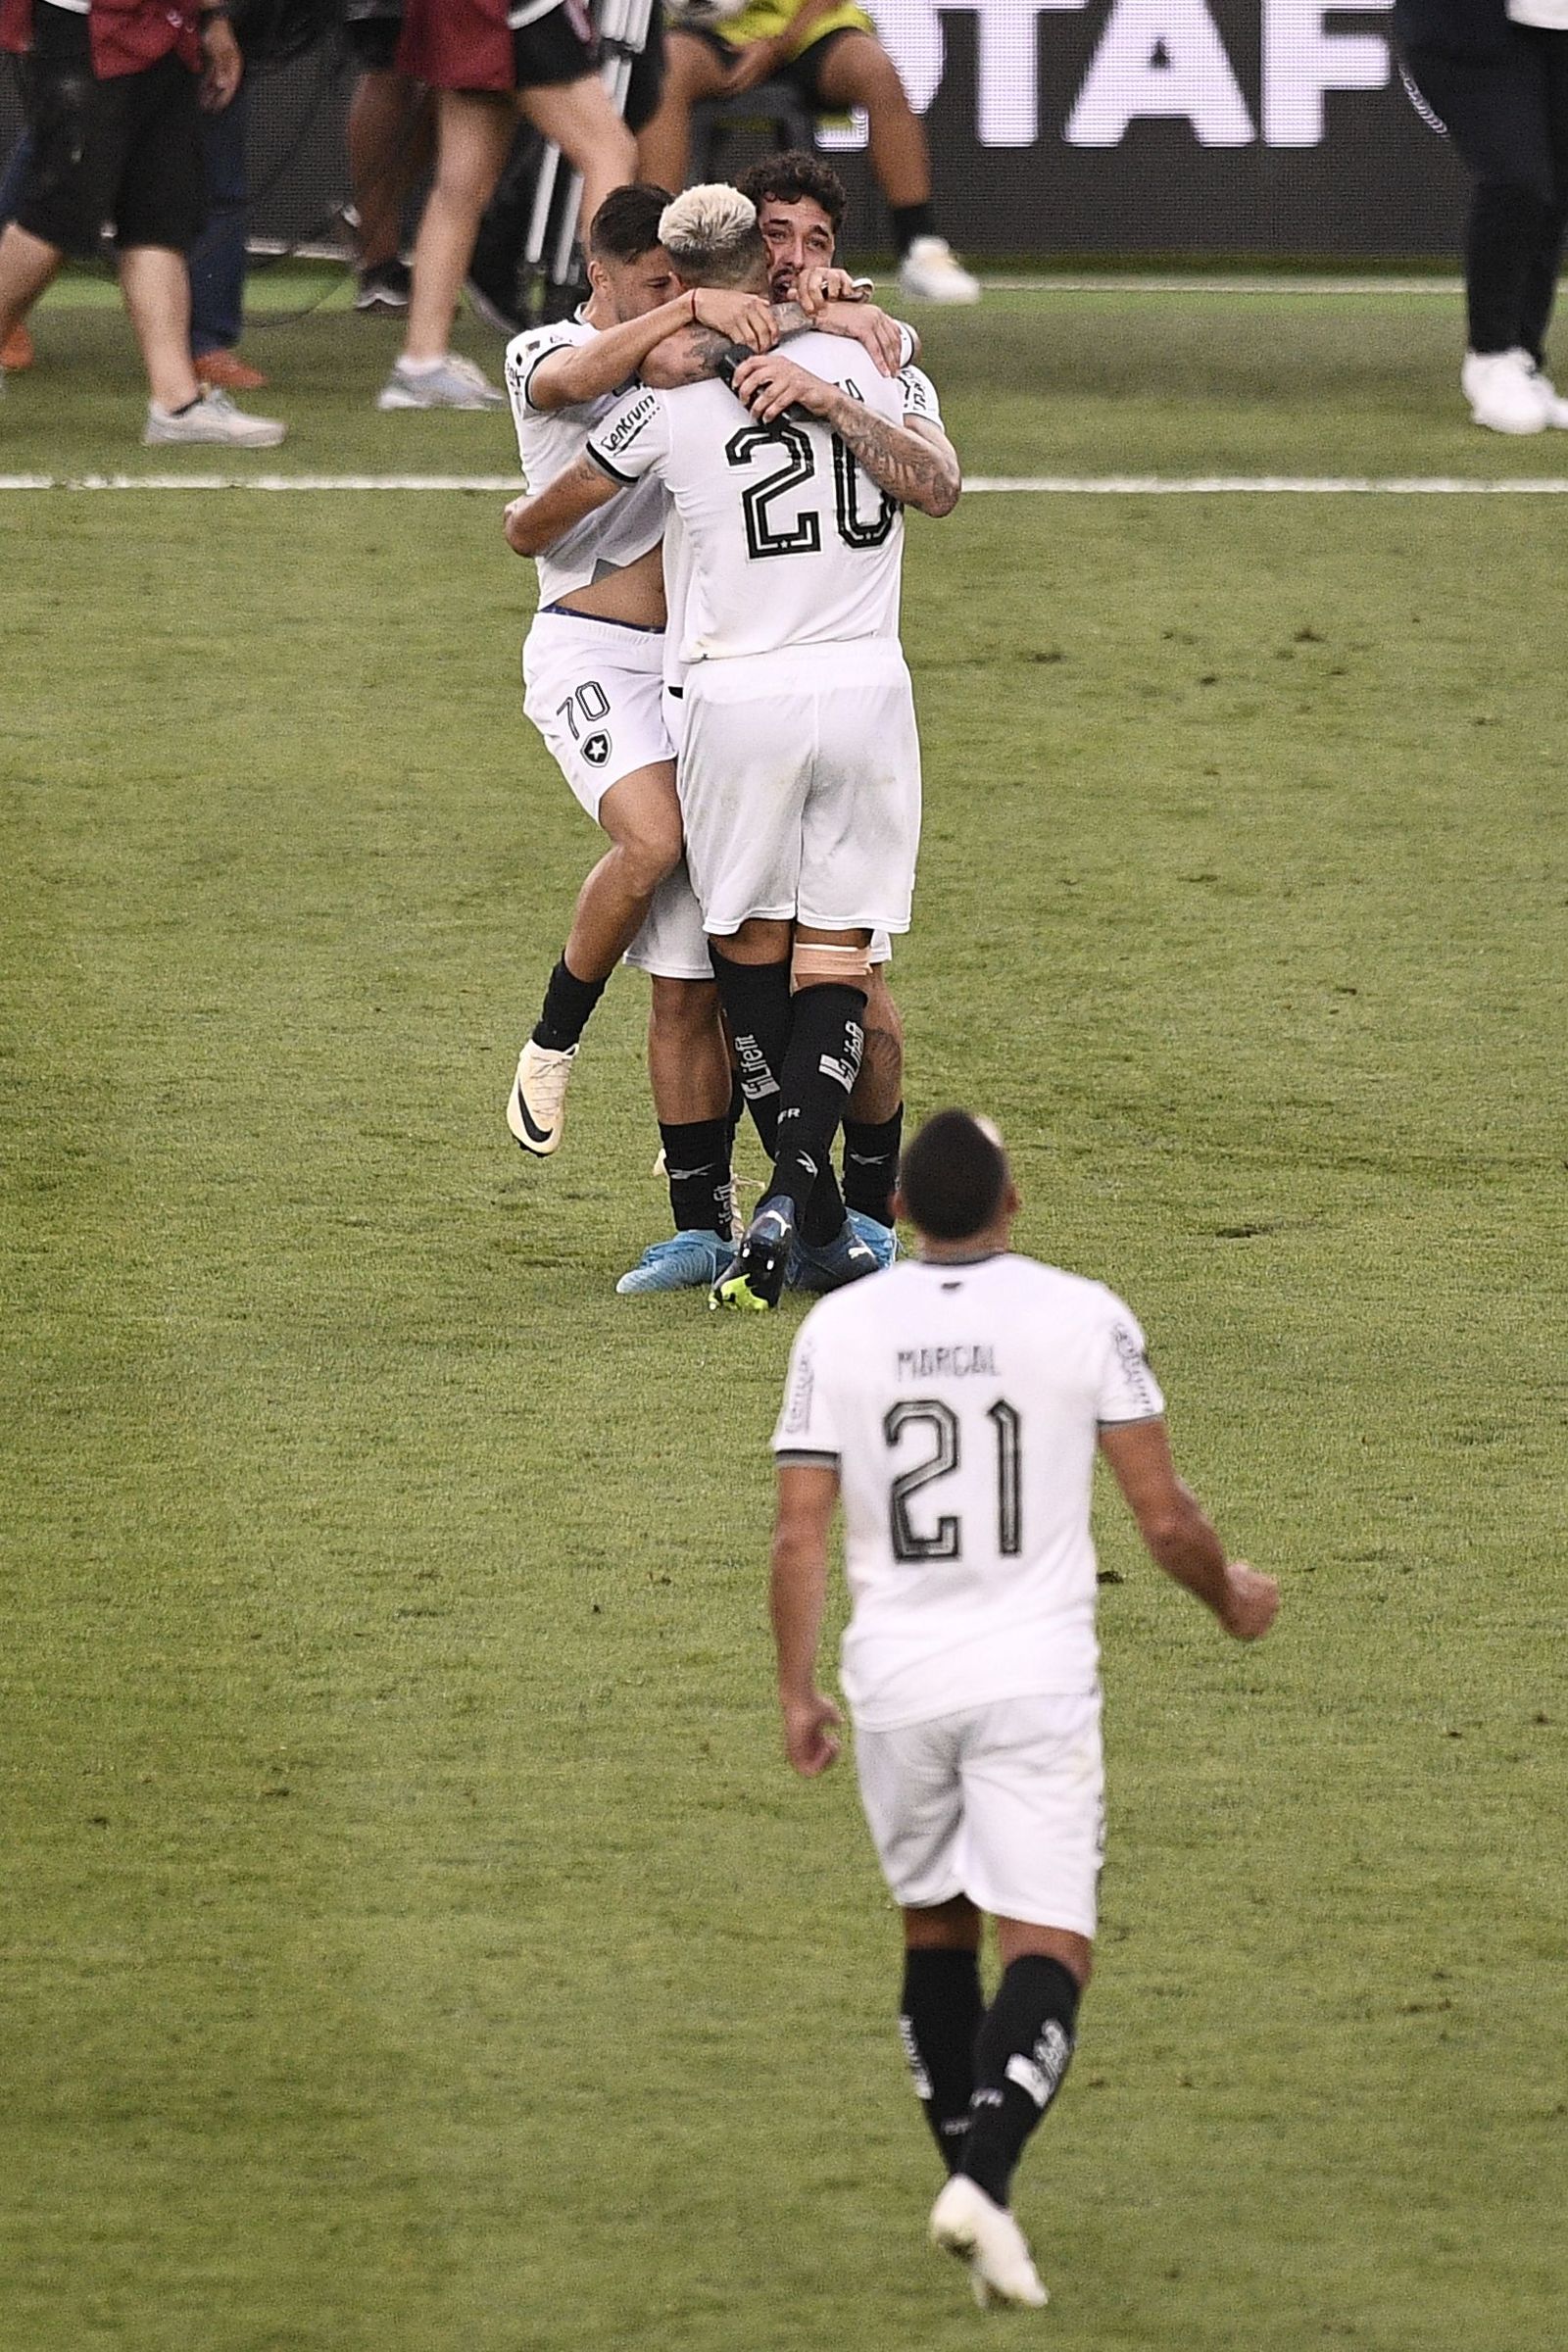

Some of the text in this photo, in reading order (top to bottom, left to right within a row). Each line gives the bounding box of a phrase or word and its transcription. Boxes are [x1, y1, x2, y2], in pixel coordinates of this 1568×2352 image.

[600, 394, 657, 453] Centrum
[556, 680, 611, 741] 70
[883, 1399, 1022, 1562] 21
